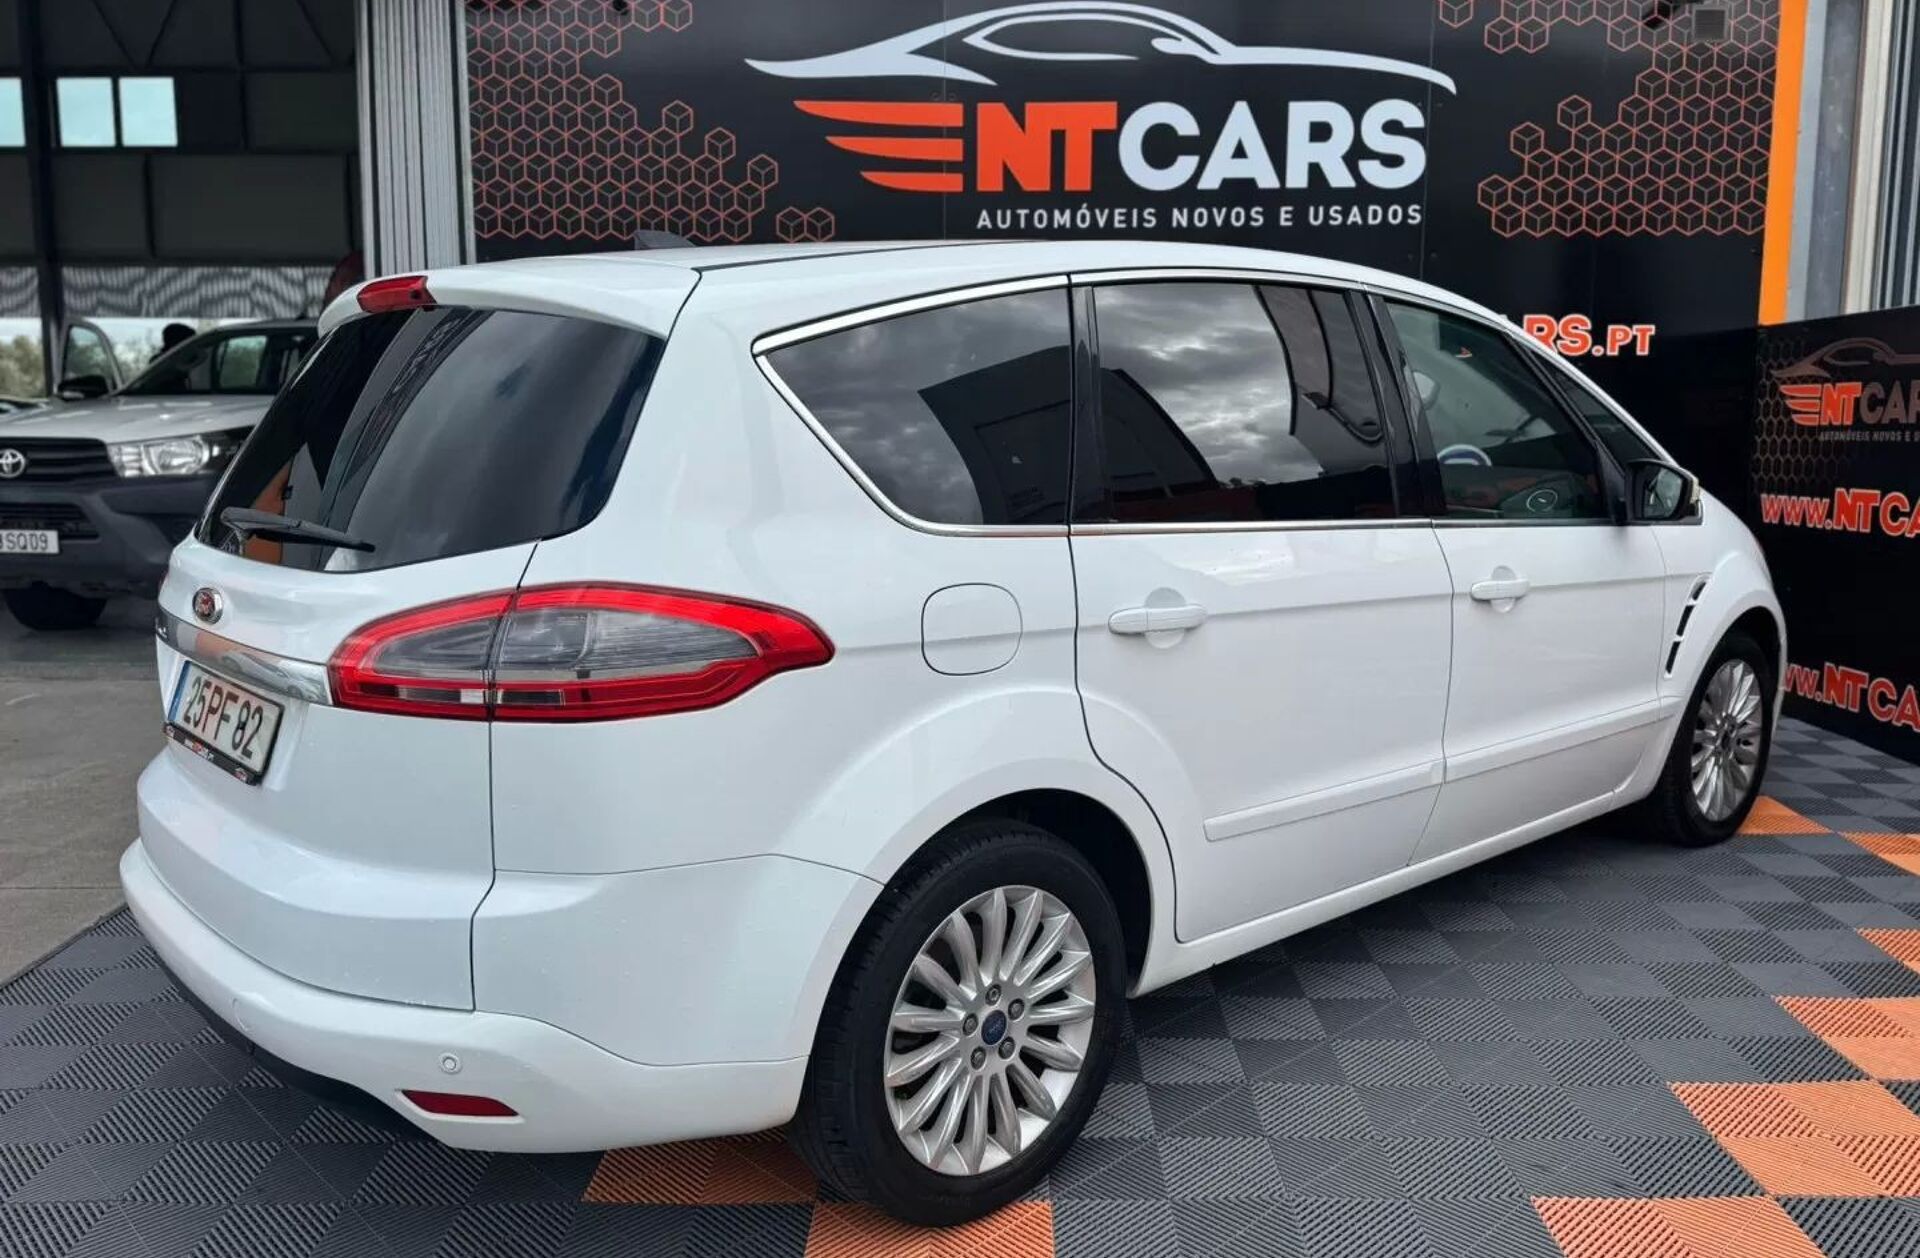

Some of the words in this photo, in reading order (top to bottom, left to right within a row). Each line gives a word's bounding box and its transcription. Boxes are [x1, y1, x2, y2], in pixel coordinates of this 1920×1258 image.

[976, 203, 1157, 229] AUTOMÓVEIS
[1171, 207, 1264, 227] NOVOS
[1279, 206, 1294, 226] E
[1309, 204, 1422, 225] USADOS
